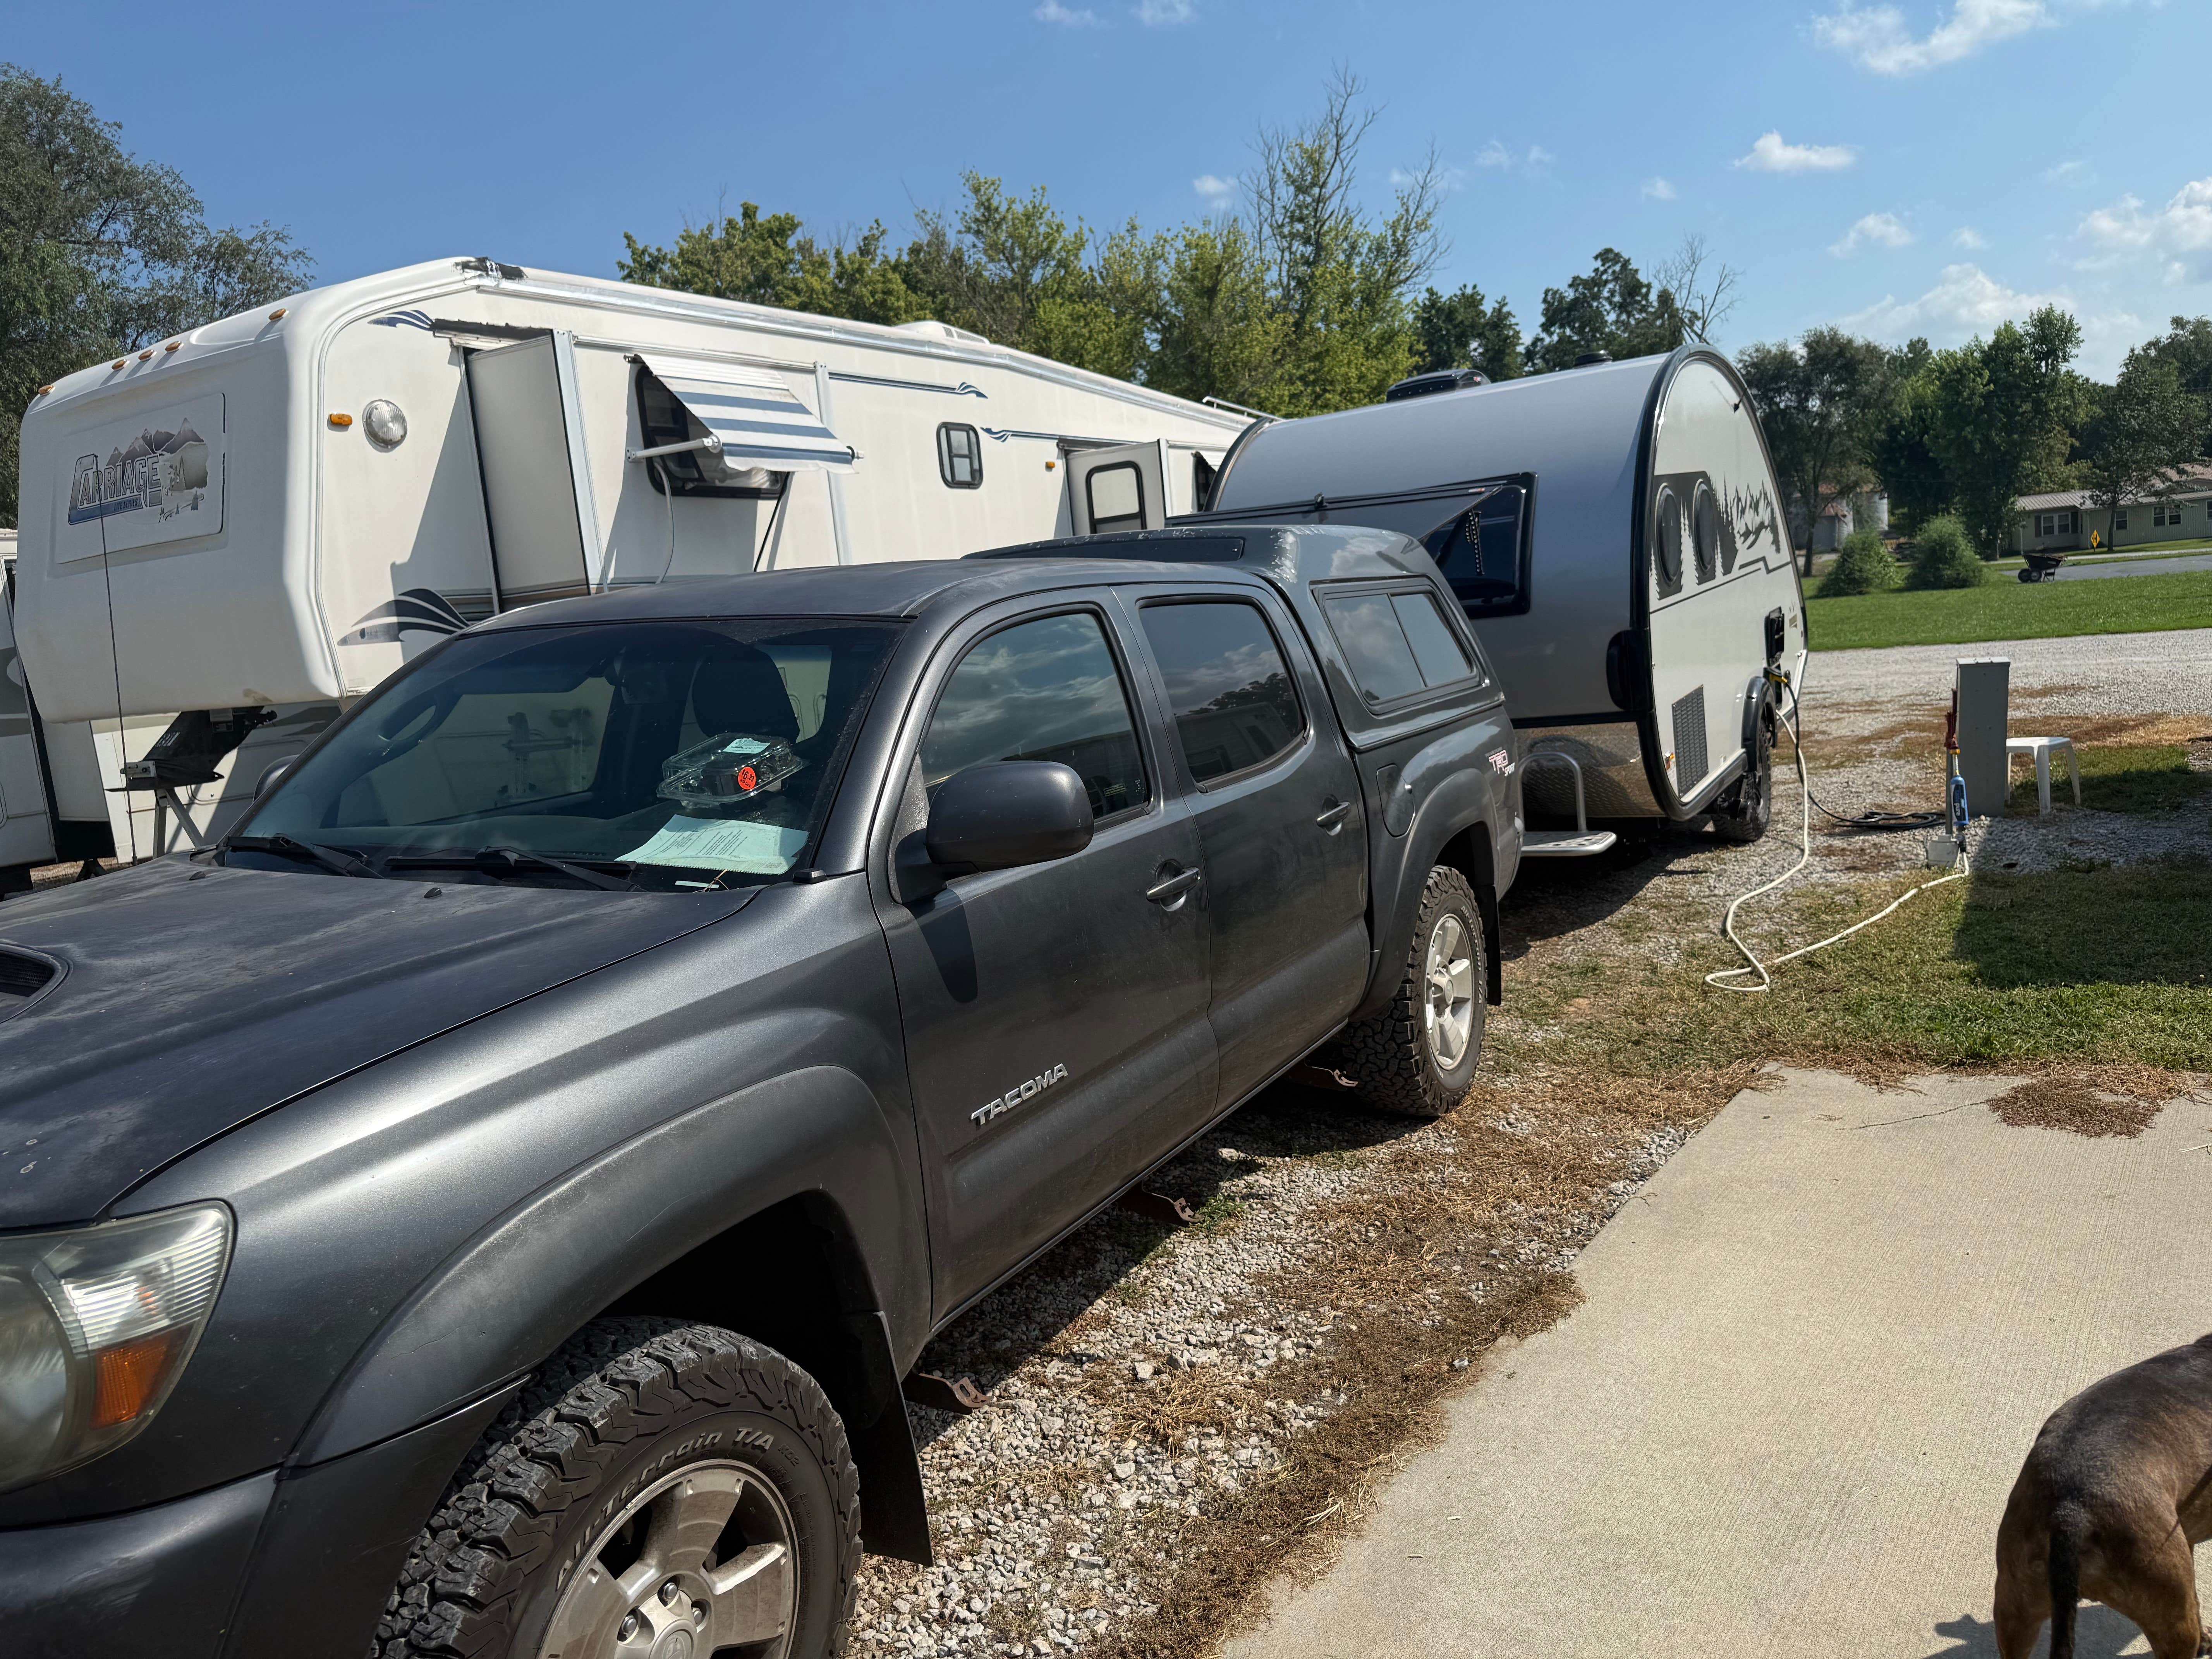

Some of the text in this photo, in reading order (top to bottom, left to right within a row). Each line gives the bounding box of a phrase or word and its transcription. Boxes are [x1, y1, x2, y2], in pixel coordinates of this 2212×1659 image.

[1488, 750, 1508, 774] TRD
[1504, 762, 1515, 776] SPORT
[971, 1063, 1068, 1125] TACOMA
[555, 1431, 723, 1592] All-Terrain
[734, 1427, 775, 1451] T/A
